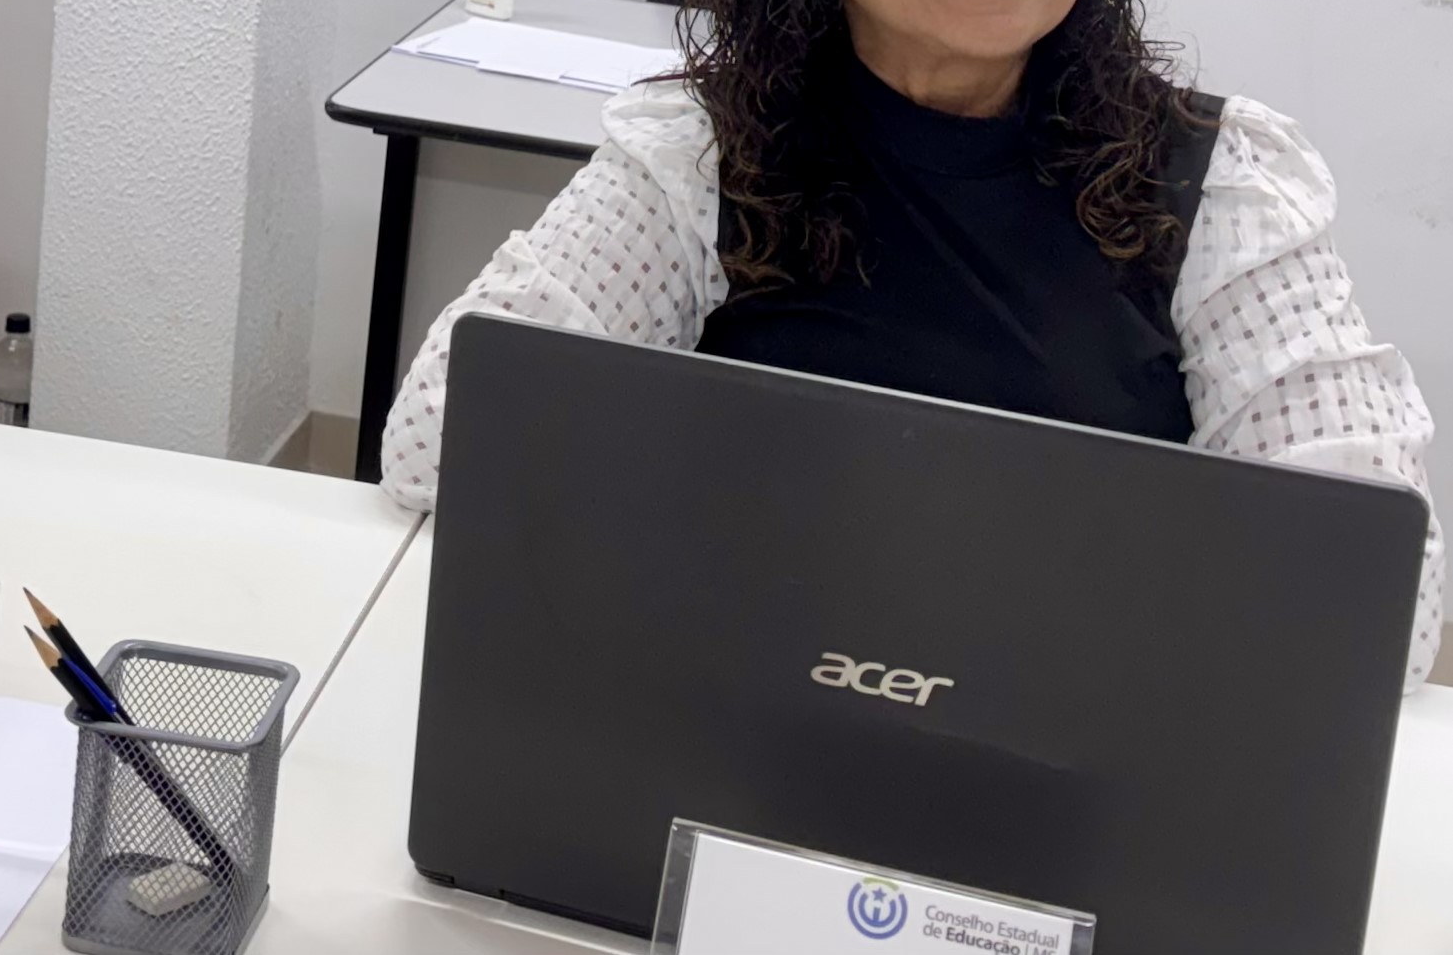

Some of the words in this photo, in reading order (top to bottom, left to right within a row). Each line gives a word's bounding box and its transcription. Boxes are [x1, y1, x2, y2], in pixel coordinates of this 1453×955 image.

[810, 652, 955, 706] acer
[922, 922, 943, 939] de
[945, 927, 1021, 955] Educação
[924, 905, 994, 934] Conselho
[997, 921, 1060, 949] Estadual
